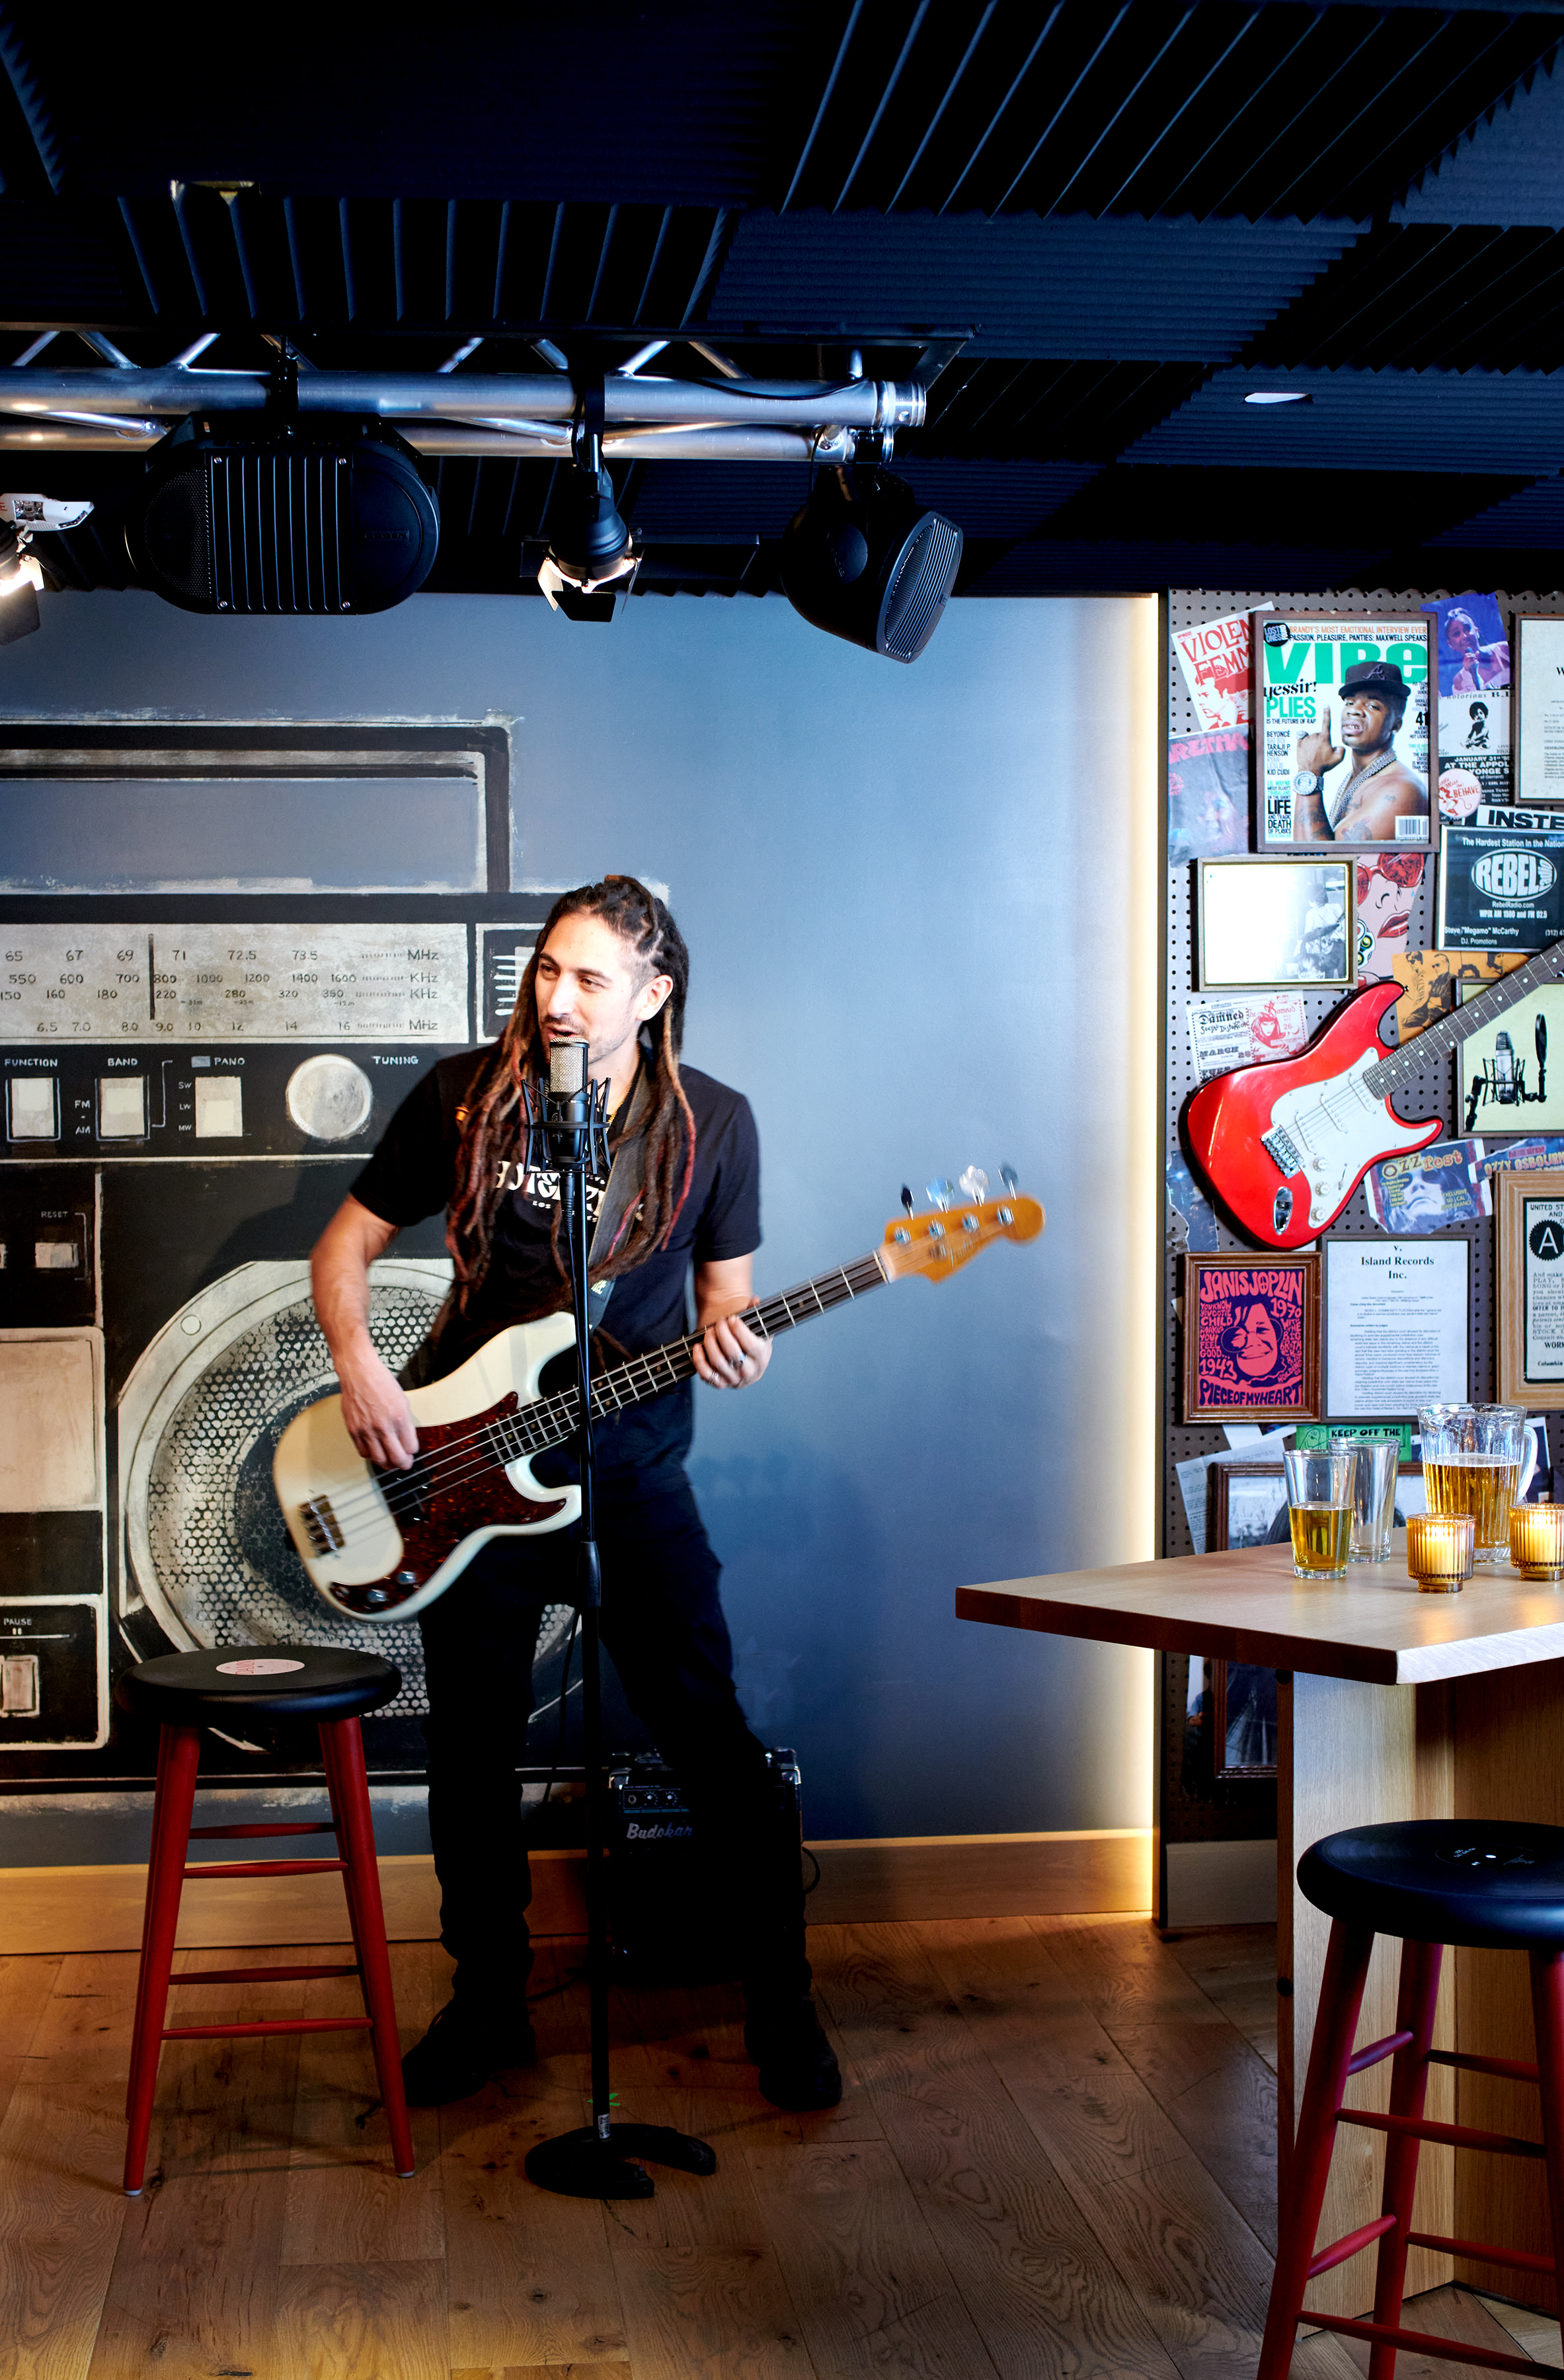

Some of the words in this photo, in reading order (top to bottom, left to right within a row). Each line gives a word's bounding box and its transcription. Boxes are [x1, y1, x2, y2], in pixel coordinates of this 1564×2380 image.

[1267, 696, 1316, 718] PLIES
[1453, 784, 1479, 799] BEHAVE
[1268, 799, 1291, 814] LIFE
[1268, 820, 1292, 828] DEATH
[1462, 836, 1475, 846] The
[1475, 838, 1501, 847] Hardest
[1502, 838, 1524, 847] Station
[1533, 839, 1544, 848] the
[1475, 853, 1539, 896] REBEL
[1492, 927, 1519, 936] McCarthy
[5, 950, 23, 961] 65
[65, 949, 83, 961] 67
[117, 949, 134, 961] 69
[173, 950, 186, 961] 71
[227, 950, 256, 960] 72.5
[292, 950, 318, 960] 73.5
[407, 949, 439, 961] MHz
[9, 974, 36, 984] 550
[59, 974, 83, 984] 600
[116, 974, 139, 984] 700
[153, 974, 176, 984] 800
[196, 974, 223, 983] 1000
[245, 974, 270, 982] 1200
[292, 973, 318, 983] 1400
[331, 973, 357, 983] 1600
[410, 972, 438, 983] KHz
[46, 990, 65, 999] 160
[97, 990, 118, 999] 180
[155, 990, 176, 999] 220
[225, 990, 246, 998] 280
[278, 990, 298, 998] 320
[323, 990, 344, 998] 350
[410, 989, 438, 999] KHz
[1198, 1010, 1243, 1025] Damned
[37, 1022, 58, 1032] 6.5
[72, 1022, 91, 1032] 7.0
[122, 1022, 139, 1031] 8.0
[155, 1023, 174, 1032] 9.0
[188, 1022, 202, 1031] 10
[232, 1022, 245, 1031] 12
[285, 1021, 297, 1031] 14
[338, 1021, 350, 1031] 16
[409, 1020, 438, 1031] MHz
[1199, 1046, 1239, 1058] MARCH
[5, 1058, 58, 1068] FUNCTION
[108, 1058, 138, 1066] BAND
[214, 1057, 245, 1066] PANO
[371, 1056, 418, 1065] TUNING
[75, 1100, 91, 1109] FM
[75, 1126, 91, 1134] AM
[1442, 1189, 1467, 1197] EXCLUSIVE
[1538, 1226, 1559, 1254] A
[1361, 1257, 1391, 1265] Island
[1395, 1257, 1434, 1265] Records
[1388, 1270, 1407, 1279] Inc.
[1200, 1271, 1249, 1302] JANIS
[1249, 1271, 1303, 1306] JOPLIN
[1271, 1298, 1302, 1318] 1970
[1200, 1316, 1233, 1326] CHILD
[1284, 1331, 1301, 1340] BIG
[1200, 1335, 1220, 1349] FEEL
[1200, 1359, 1237, 1380] 1943
[1199, 1378, 1233, 1406] PIECE
[1233, 1391, 1245, 1405] OF
[1245, 1392, 1260, 1406] MY
[1259, 1380, 1302, 1405] HEART
[1383, 1428, 1401, 1437] THE
